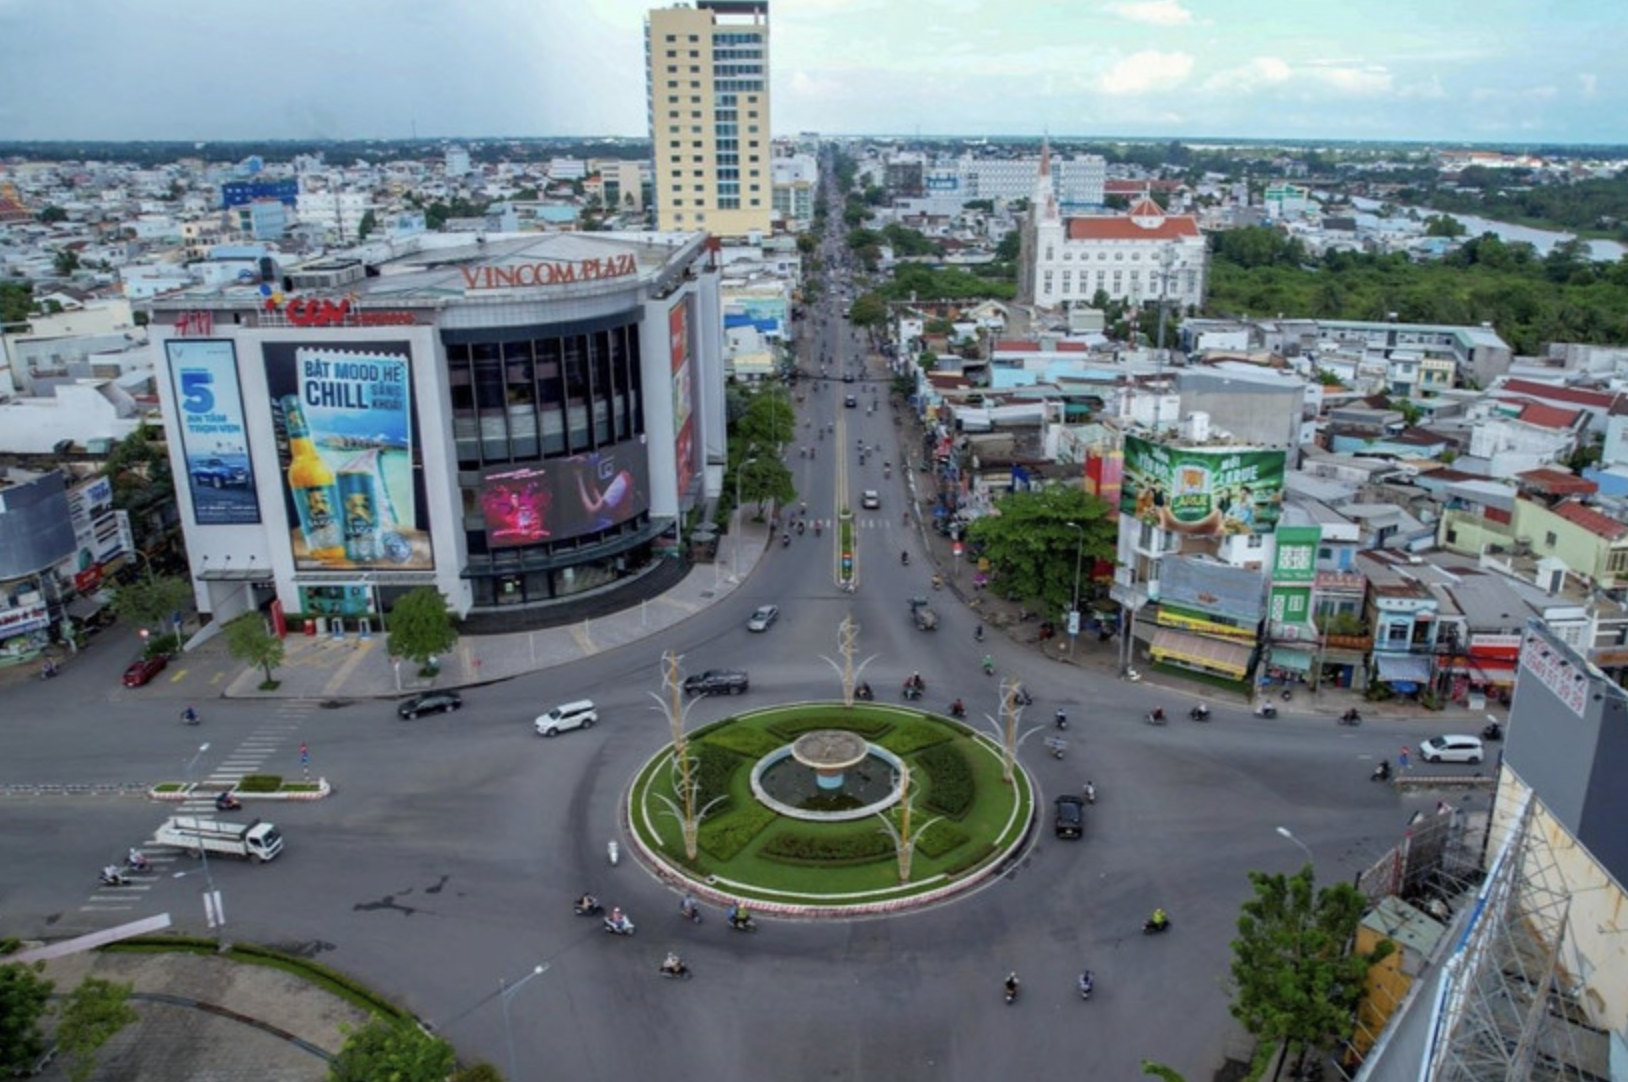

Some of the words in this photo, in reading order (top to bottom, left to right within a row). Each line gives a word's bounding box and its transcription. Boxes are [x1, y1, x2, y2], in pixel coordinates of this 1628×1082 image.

[461, 263, 575, 289] VINCOM
[581, 254, 637, 281] PLAZA
[334, 362, 379, 381] MOOD
[180, 372, 214, 414] 5
[305, 381, 369, 409] CHILL
